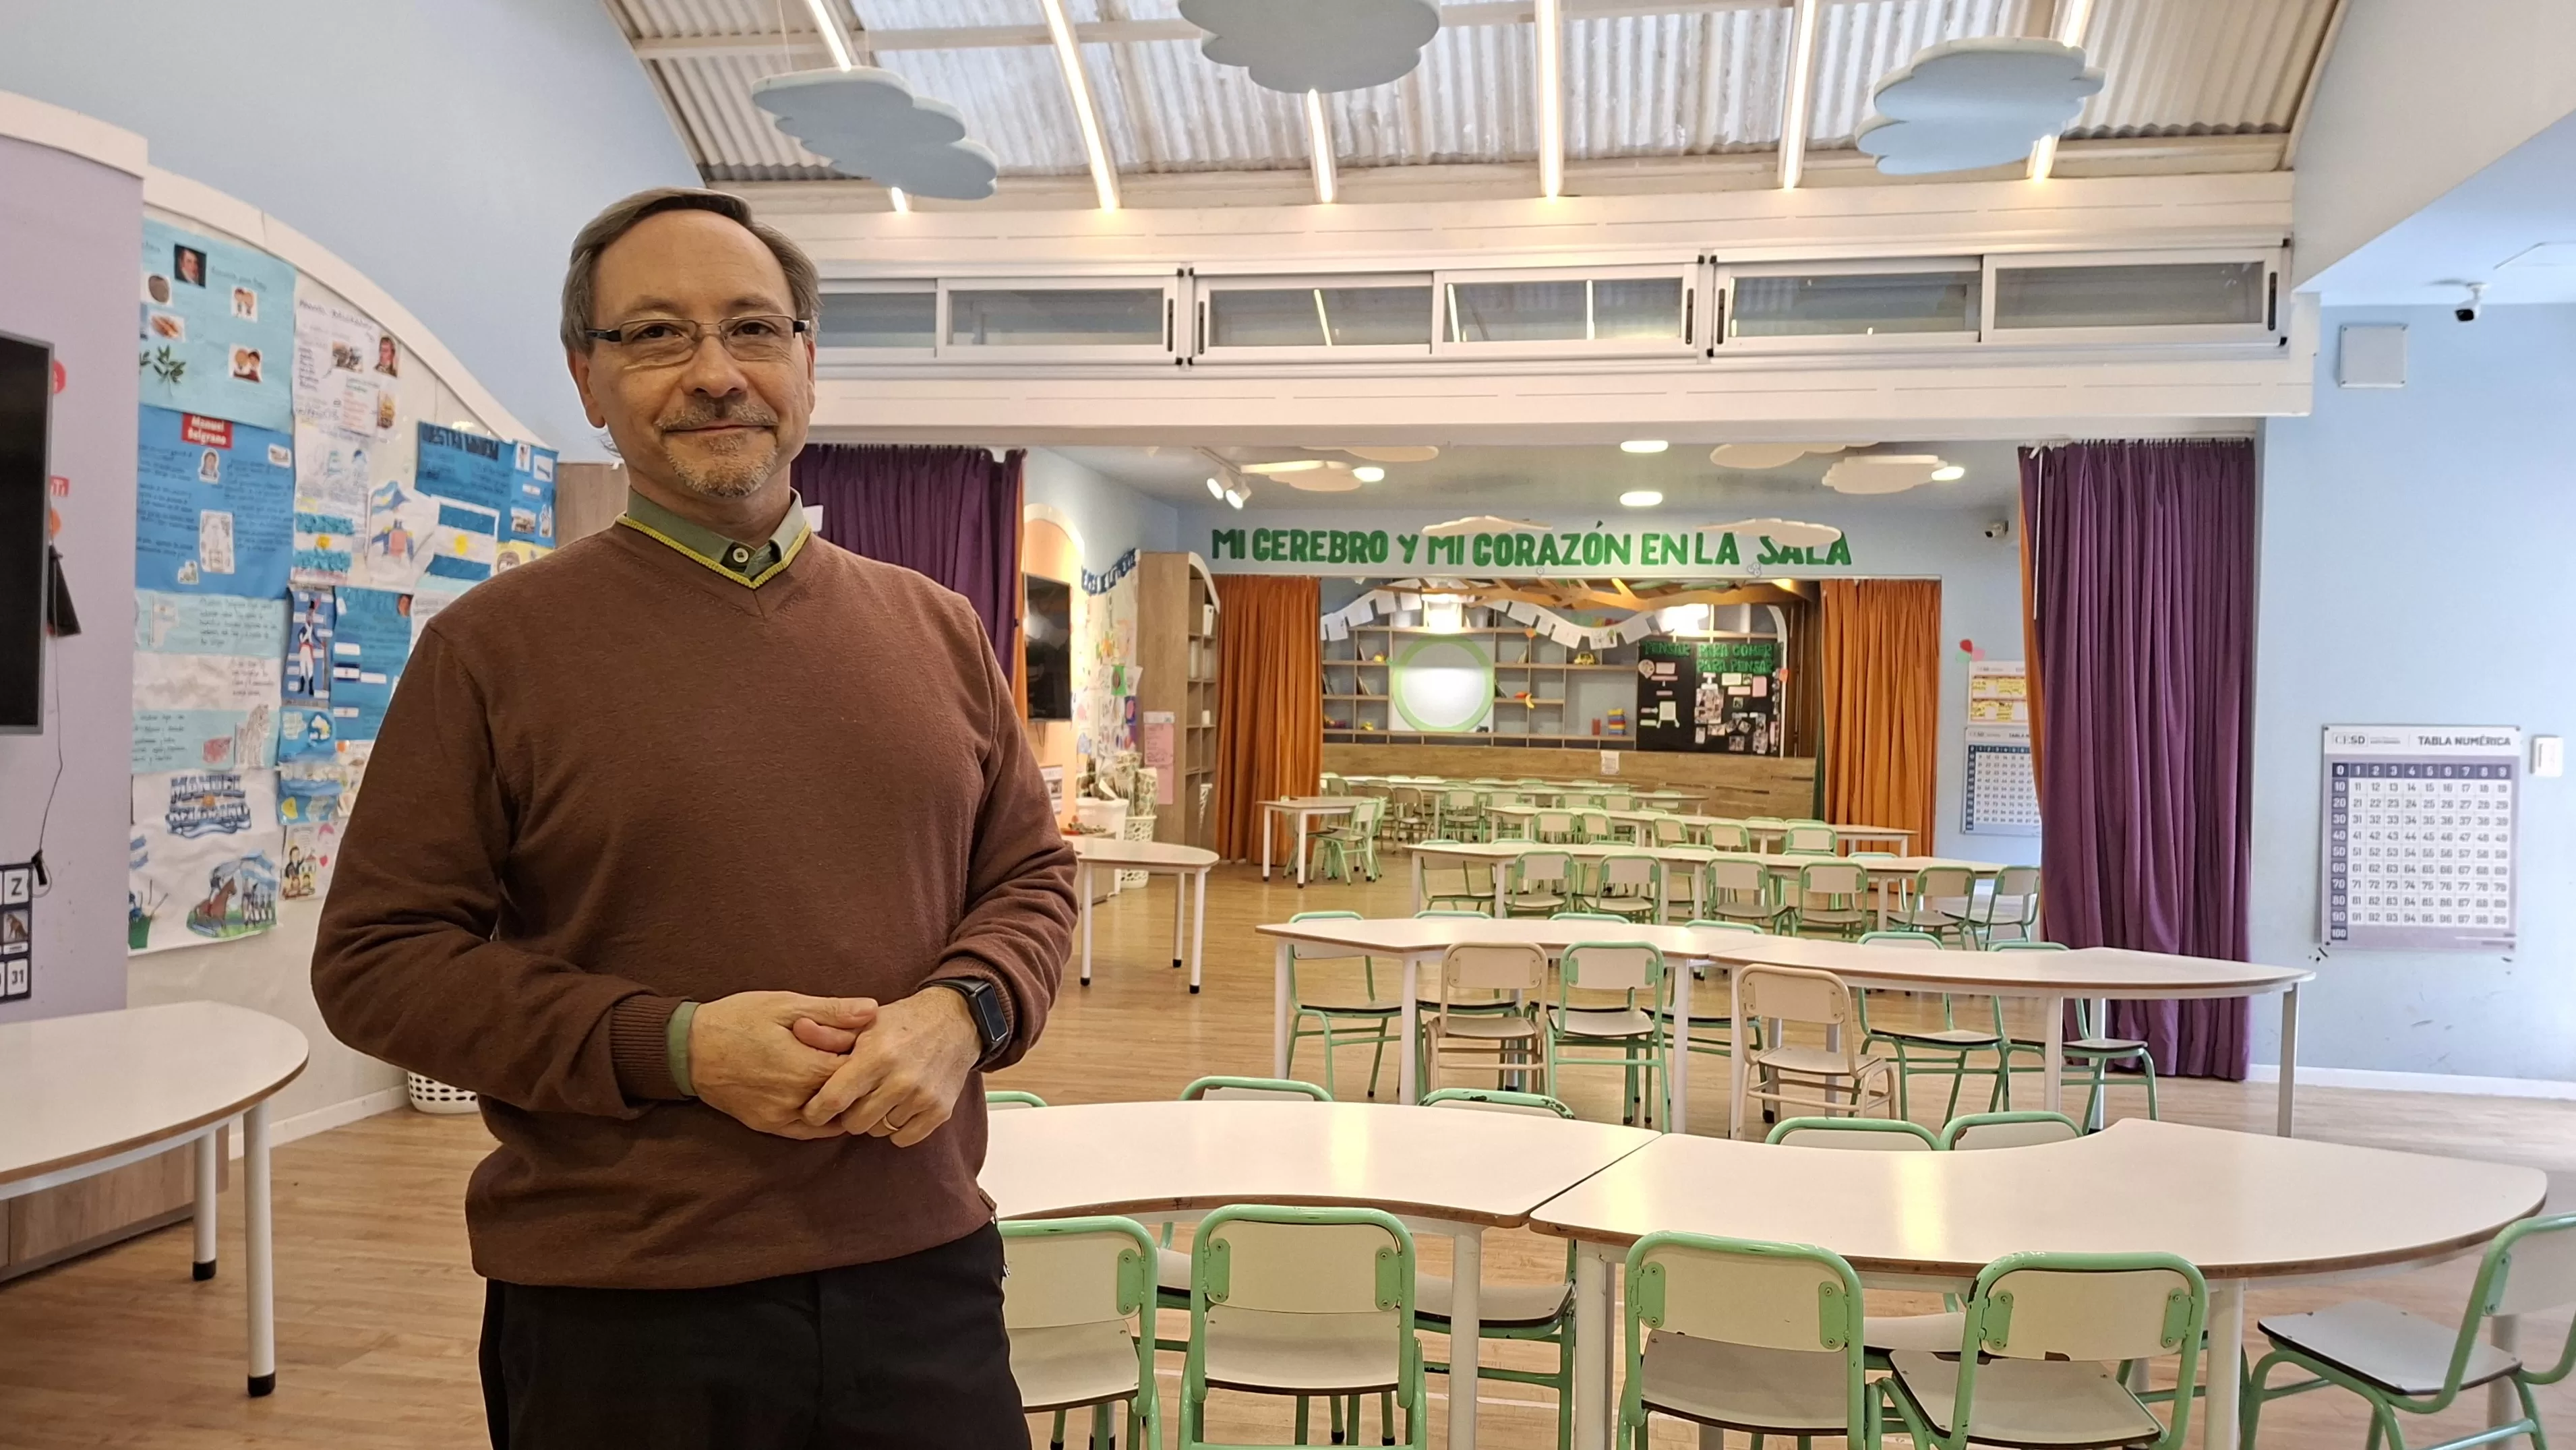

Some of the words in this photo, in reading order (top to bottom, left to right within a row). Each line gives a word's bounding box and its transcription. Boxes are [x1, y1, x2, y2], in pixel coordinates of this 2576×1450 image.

[187, 425, 227, 446] Belgrano
[1211, 528, 1246, 560] MI
[1251, 527, 1389, 564] CEREBRO
[1397, 533, 1419, 564] Y
[1427, 535, 1464, 565] MI
[1472, 520, 1631, 567] CORAZÓN
[1640, 532, 1688, 565] EN
[1695, 531, 1741, 565] LA
[1698, 643, 1729, 657] PARA
[1732, 644, 1772, 657] COMER
[1697, 659, 1726, 673] PARA
[2418, 735, 2452, 746] TABLA
[2336, 766, 2344, 775] 0
[2354, 766, 2361, 776] 1
[2372, 766, 2380, 776] 2
[2389, 766, 2397, 776] 3
[2408, 766, 2416, 776] 4
[2426, 766, 2434, 777] 5
[2462, 766, 2470, 777] 7
[170, 775, 243, 803] MANUEL
[2355, 782, 2362, 791] 11
[2371, 782, 2380, 791] 12
[2389, 782, 2399, 791] 13
[2407, 782, 2416, 791] 14
[2425, 783, 2435, 791] 15
[2461, 783, 2471, 793] 17
[2353, 798, 2362, 808] 21
[2370, 798, 2381, 808] 22
[2388, 799, 2399, 808] 23
[2405, 799, 2416, 809] 24
[2459, 799, 2472, 809] 27
[2353, 814, 2362, 824] 31
[2369, 814, 2381, 824] 32
[2405, 816, 2416, 824] 34
[2459, 816, 2472, 825] 37
[2353, 830, 2361, 840] 41
[2369, 832, 2381, 840] 42
[2387, 832, 2399, 840] 43
[2405, 832, 2416, 841] 44
[2459, 833, 2472, 841] 47
[2353, 847, 2361, 856] 51
[2458, 848, 2470, 859] 57
[11, 877, 23, 896] Z
[2352, 879, 2361, 888] 71
[2369, 879, 2380, 890] 72
[2387, 880, 2397, 890] 73
[2405, 880, 2415, 890] 74
[2422, 880, 2434, 890] 75
[2458, 882, 2470, 891] 77
[11, 969, 24, 986] 31
